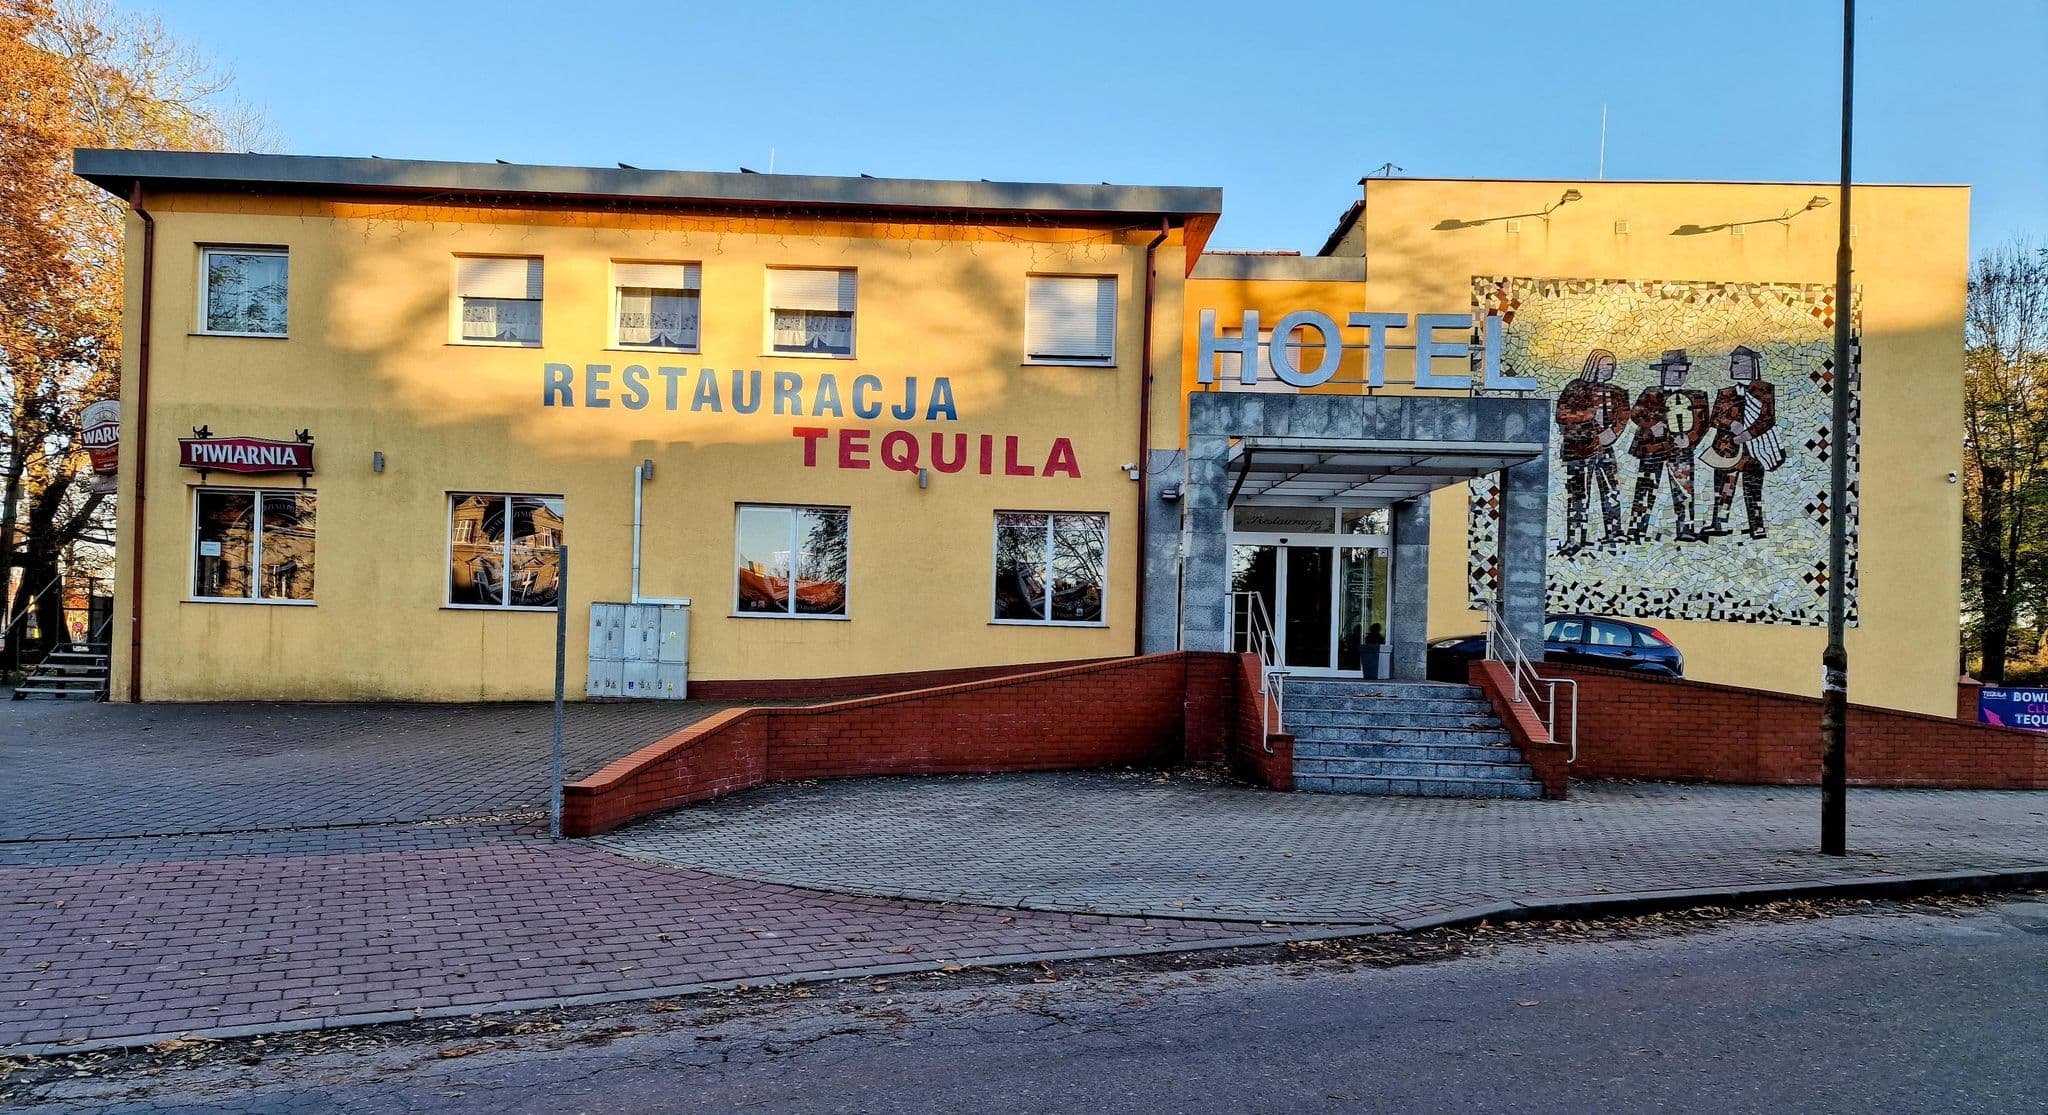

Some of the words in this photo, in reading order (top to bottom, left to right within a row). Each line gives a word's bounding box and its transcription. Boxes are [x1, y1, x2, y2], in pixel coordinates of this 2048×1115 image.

[1198, 309, 1538, 391] HOTEL
[543, 363, 958, 421] RESTAURACJA
[190, 442, 298, 466] PIWIARNIA
[792, 427, 1082, 479] TEQUILA
[1246, 514, 1323, 531] Restauracja
[2014, 714, 2048, 727] TEQU
